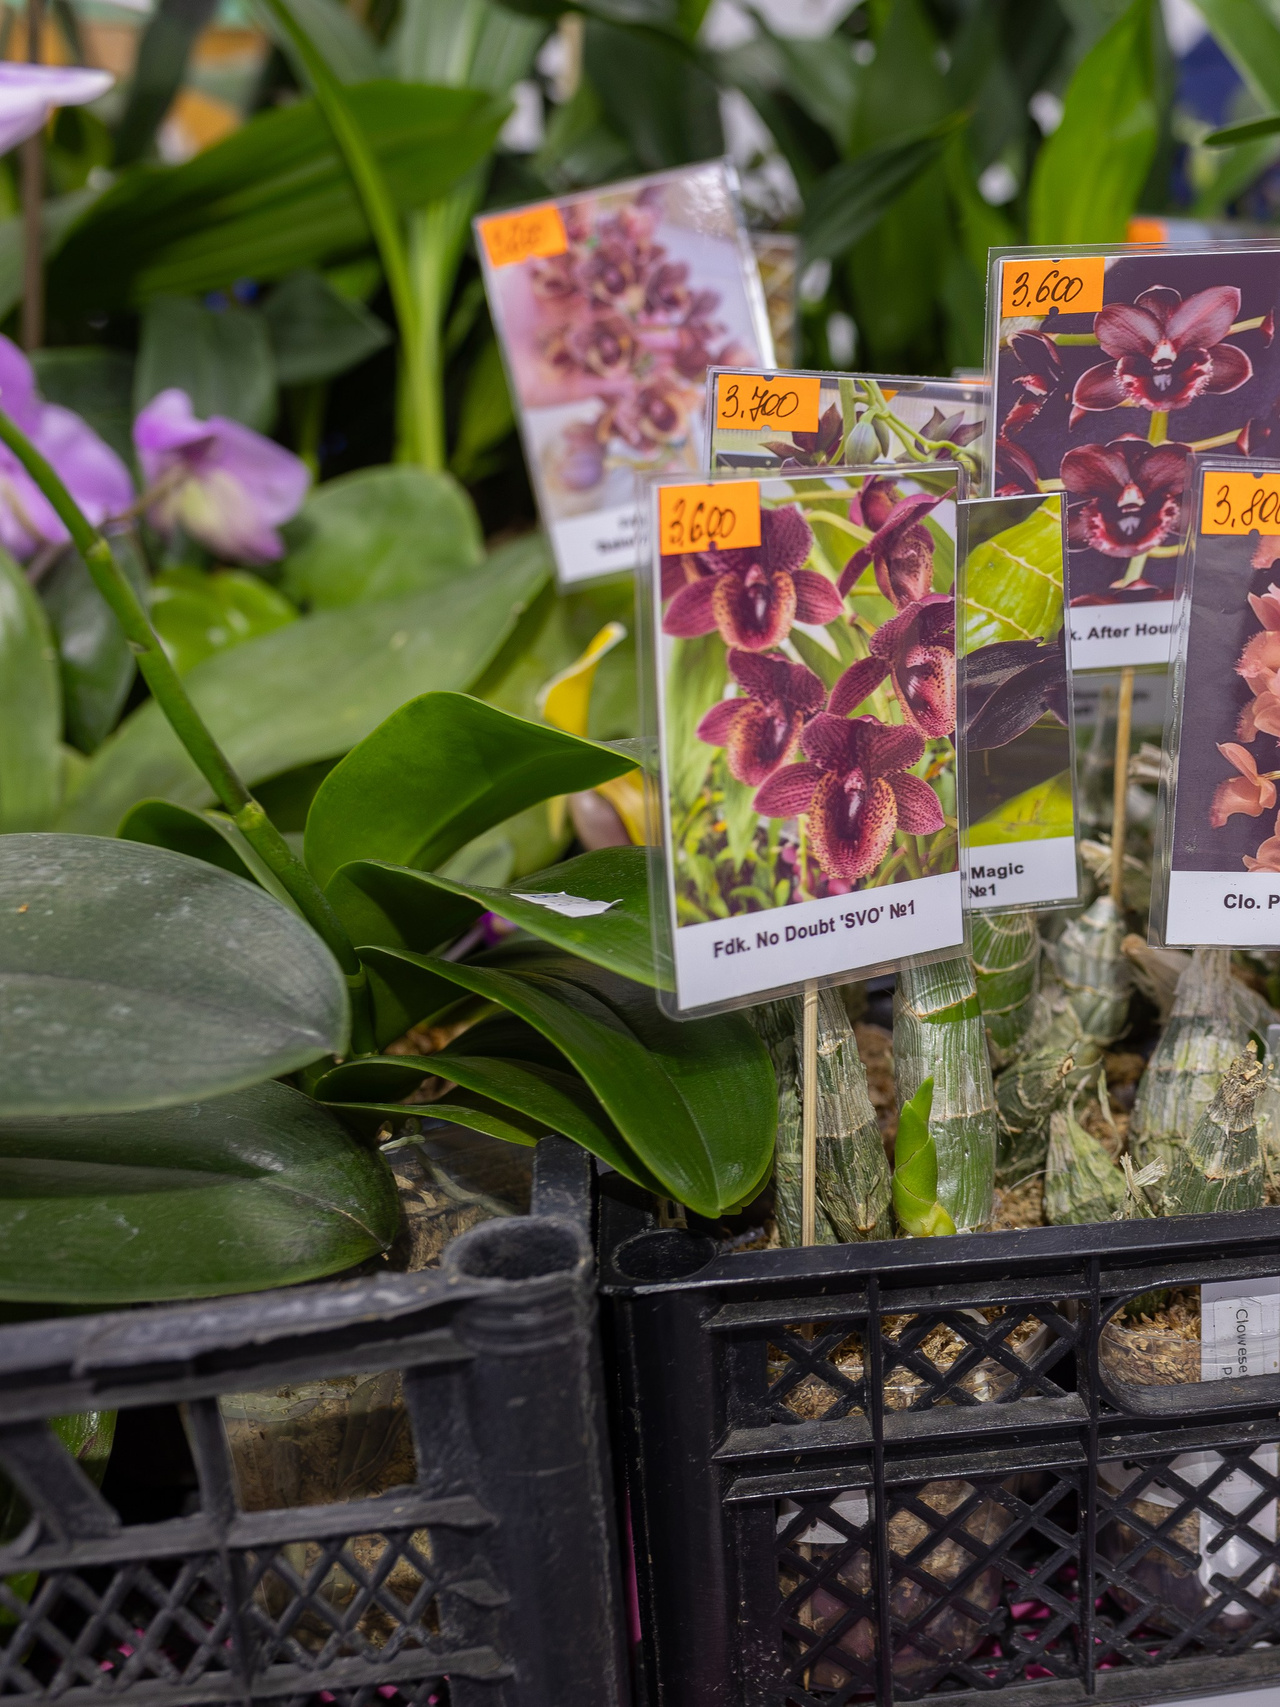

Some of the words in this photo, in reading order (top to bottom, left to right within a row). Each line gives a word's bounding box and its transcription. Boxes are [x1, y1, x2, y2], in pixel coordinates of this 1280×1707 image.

[1087, 625, 1131, 641] After
[971, 862, 1025, 880] Magic
[1223, 893, 1261, 910] Clo.
[713, 936, 751, 959] Fdk.
[756, 930, 780, 949] No
[785, 917, 836, 942] Doubt
[840, 905, 885, 929] 'SVO'
